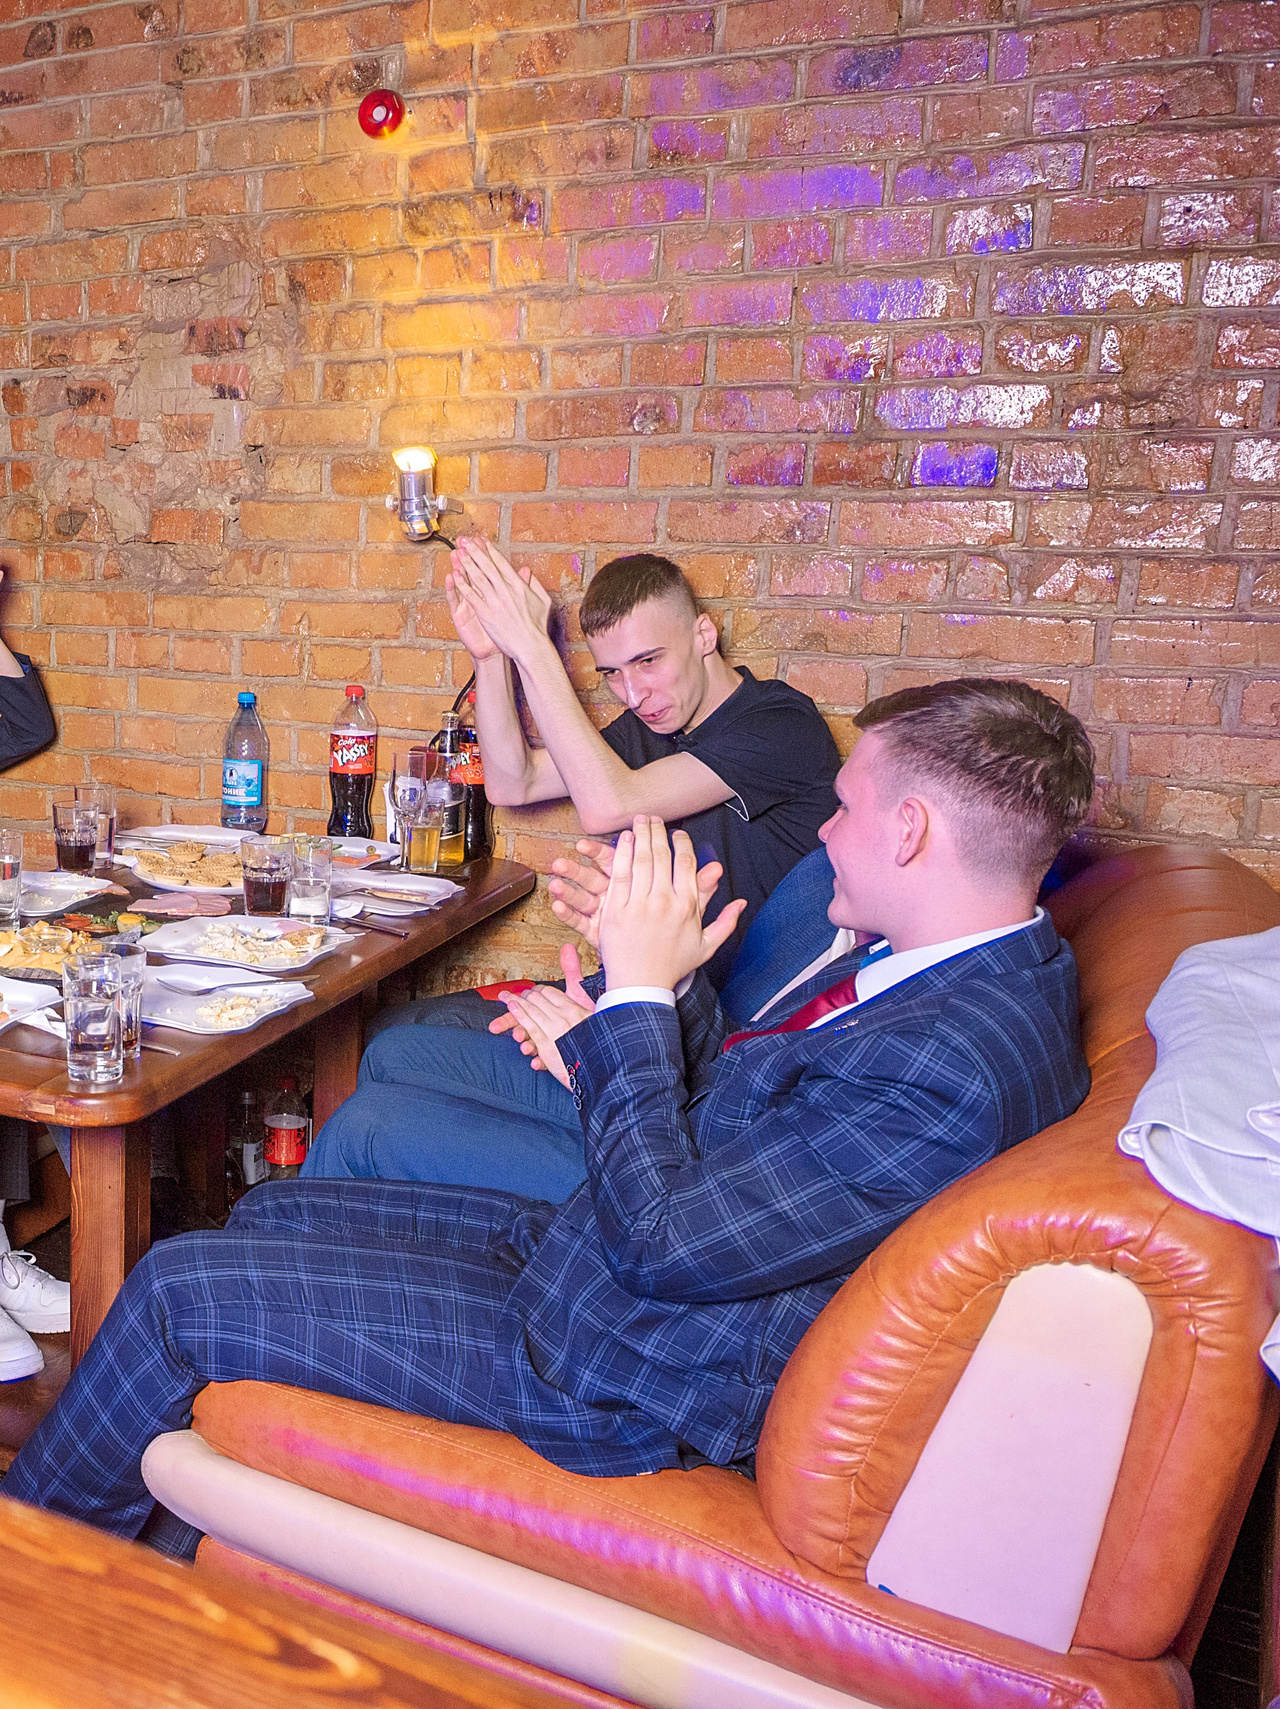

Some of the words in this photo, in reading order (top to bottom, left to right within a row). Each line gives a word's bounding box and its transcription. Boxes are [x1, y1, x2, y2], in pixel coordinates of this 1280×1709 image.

[338, 737, 356, 746] Cola
[333, 743, 368, 767] YASSEY
[222, 786, 247, 797] ОНИК
